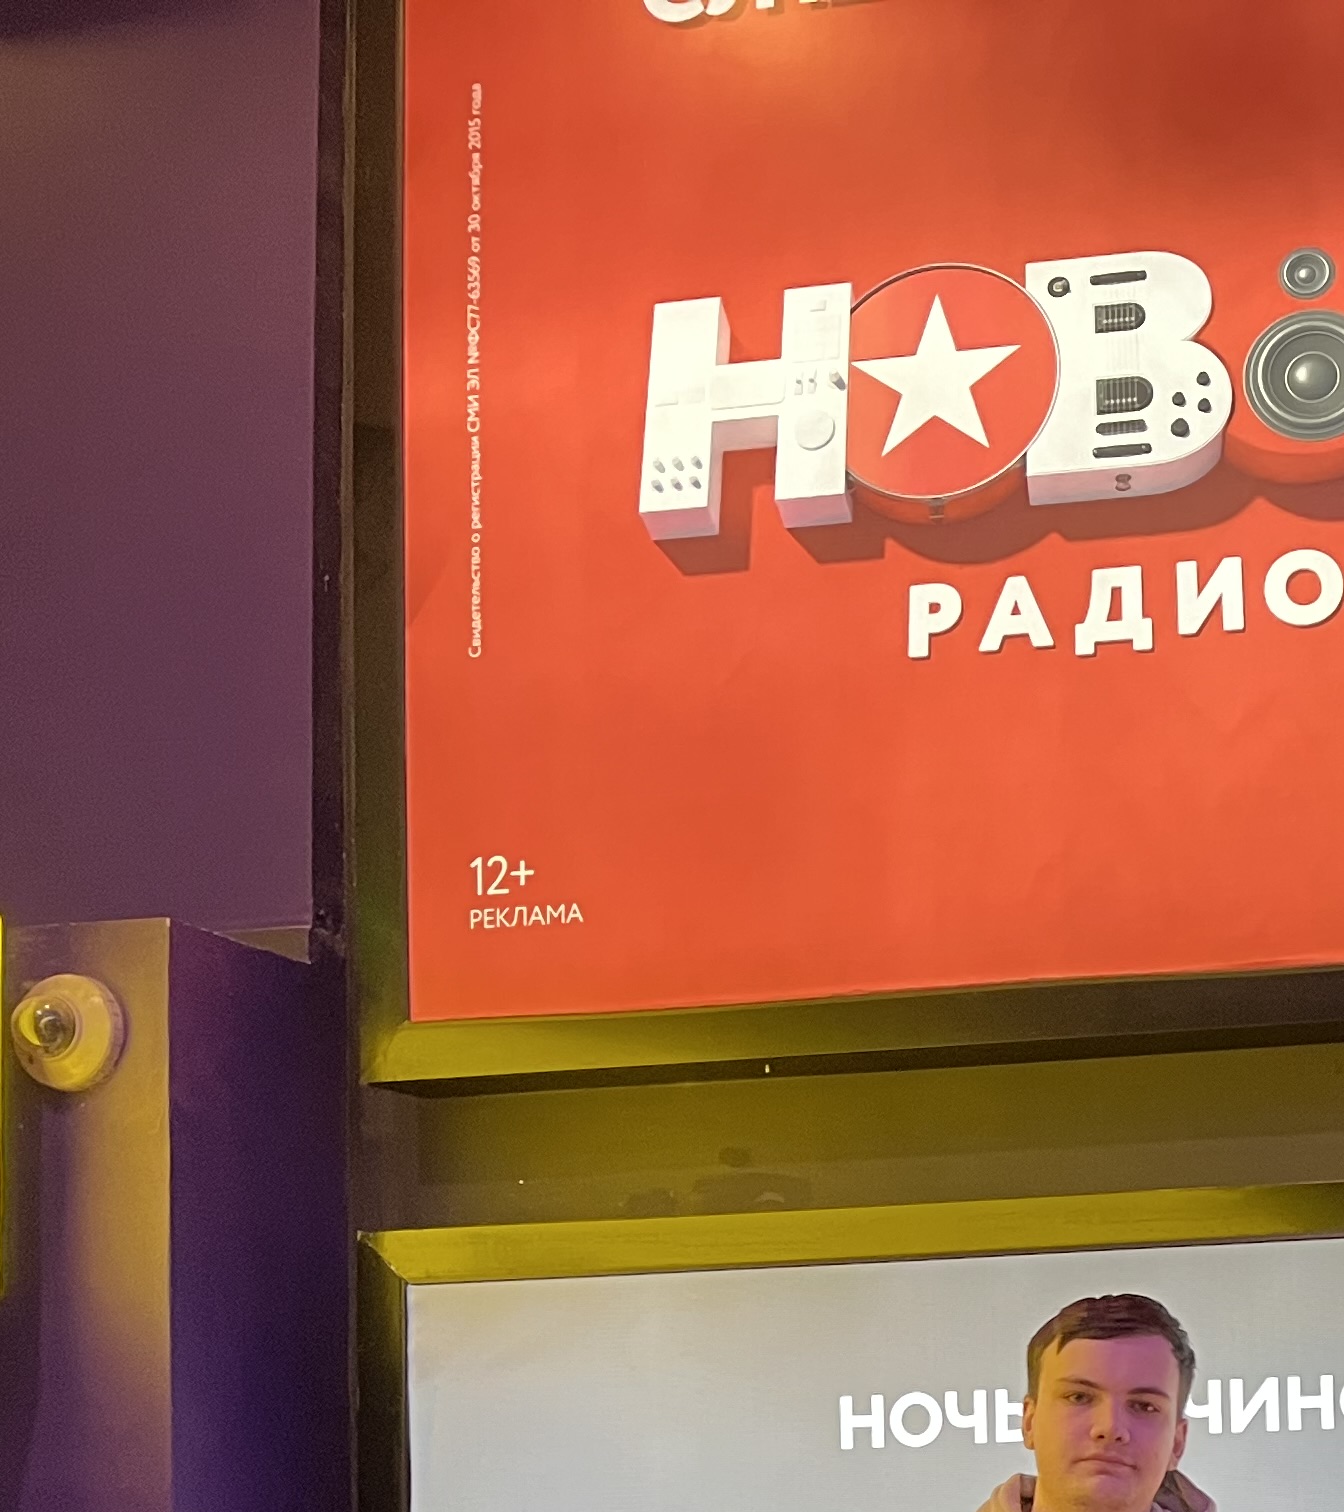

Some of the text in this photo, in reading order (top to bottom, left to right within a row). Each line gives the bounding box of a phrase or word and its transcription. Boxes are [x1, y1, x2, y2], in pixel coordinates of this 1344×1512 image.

[467, 117, 482, 150] 2015
[467, 213, 481, 233] 30
[466, 394, 481, 433] СМИ
[907, 548, 1344, 661] РАДИО
[469, 855, 535, 896] 12+
[469, 902, 584, 930] РЕКЛАМА
